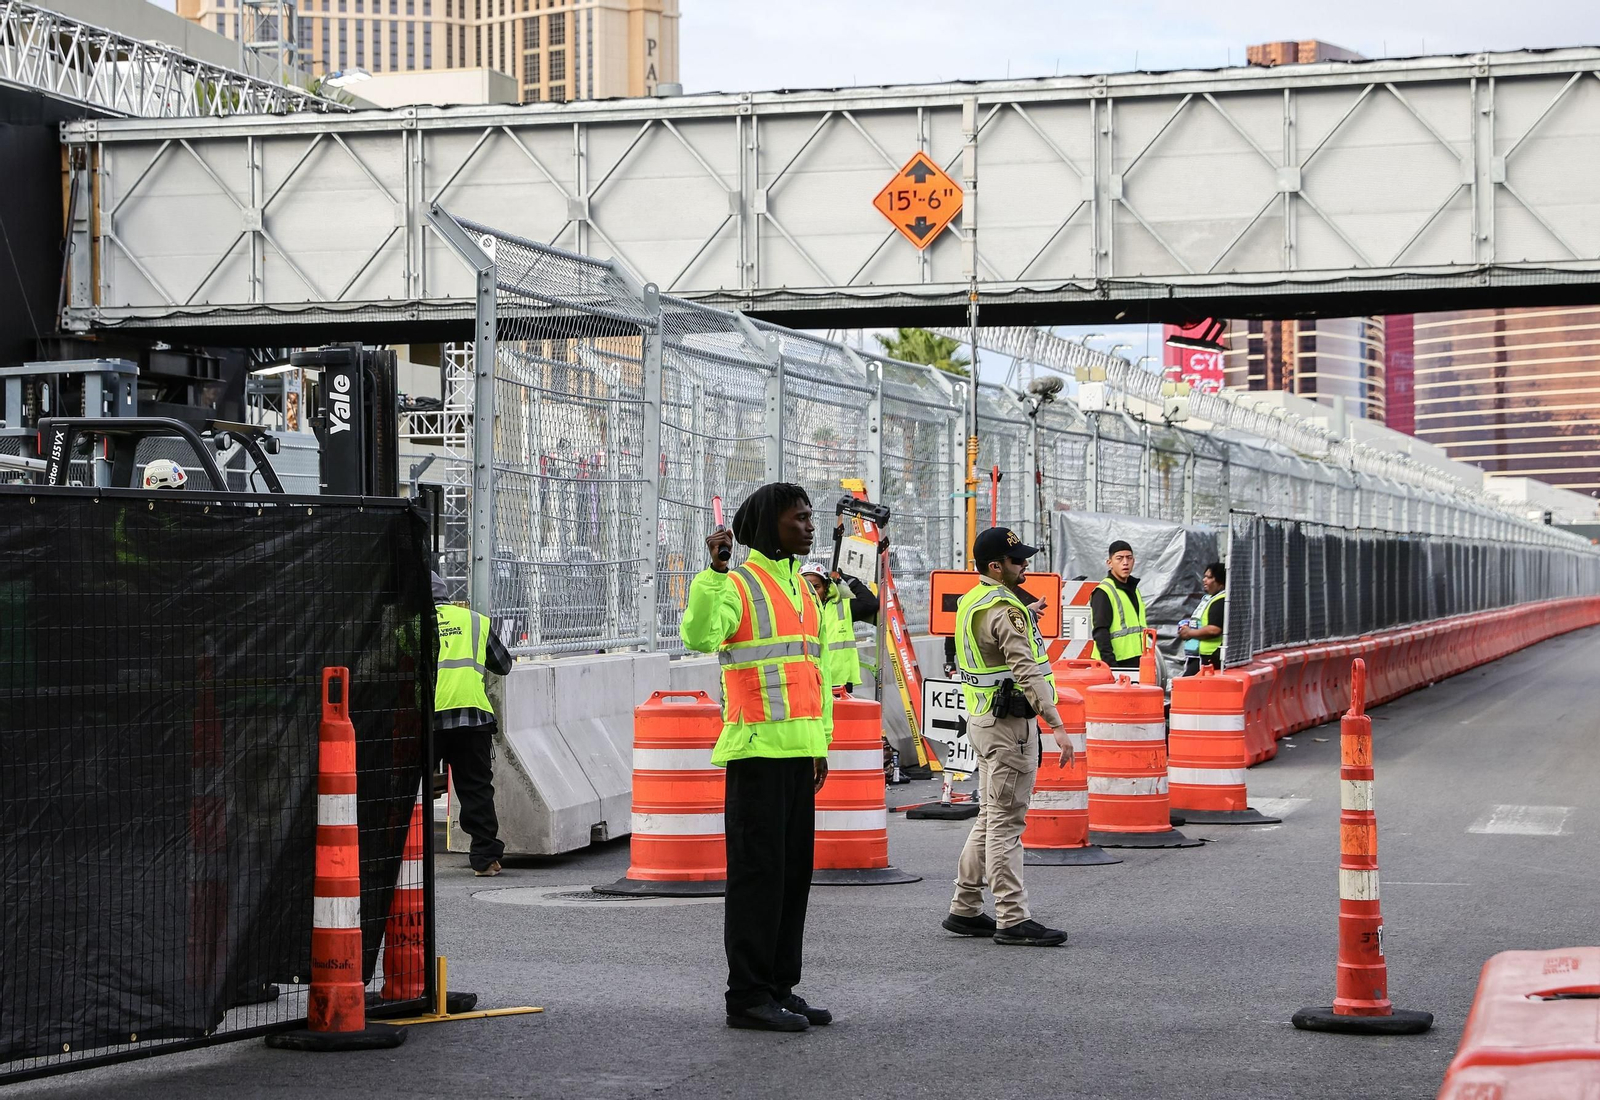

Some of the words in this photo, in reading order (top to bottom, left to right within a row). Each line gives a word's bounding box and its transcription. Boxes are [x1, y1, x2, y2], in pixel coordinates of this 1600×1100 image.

[329, 374, 351, 435] Yale
[51, 430, 65, 461] 155VX
[846, 549, 864, 569] F1
[1081, 617, 1088, 626] 2
[899, 647, 914, 682] LEANSAFE
[931, 691, 966, 710] KEE
